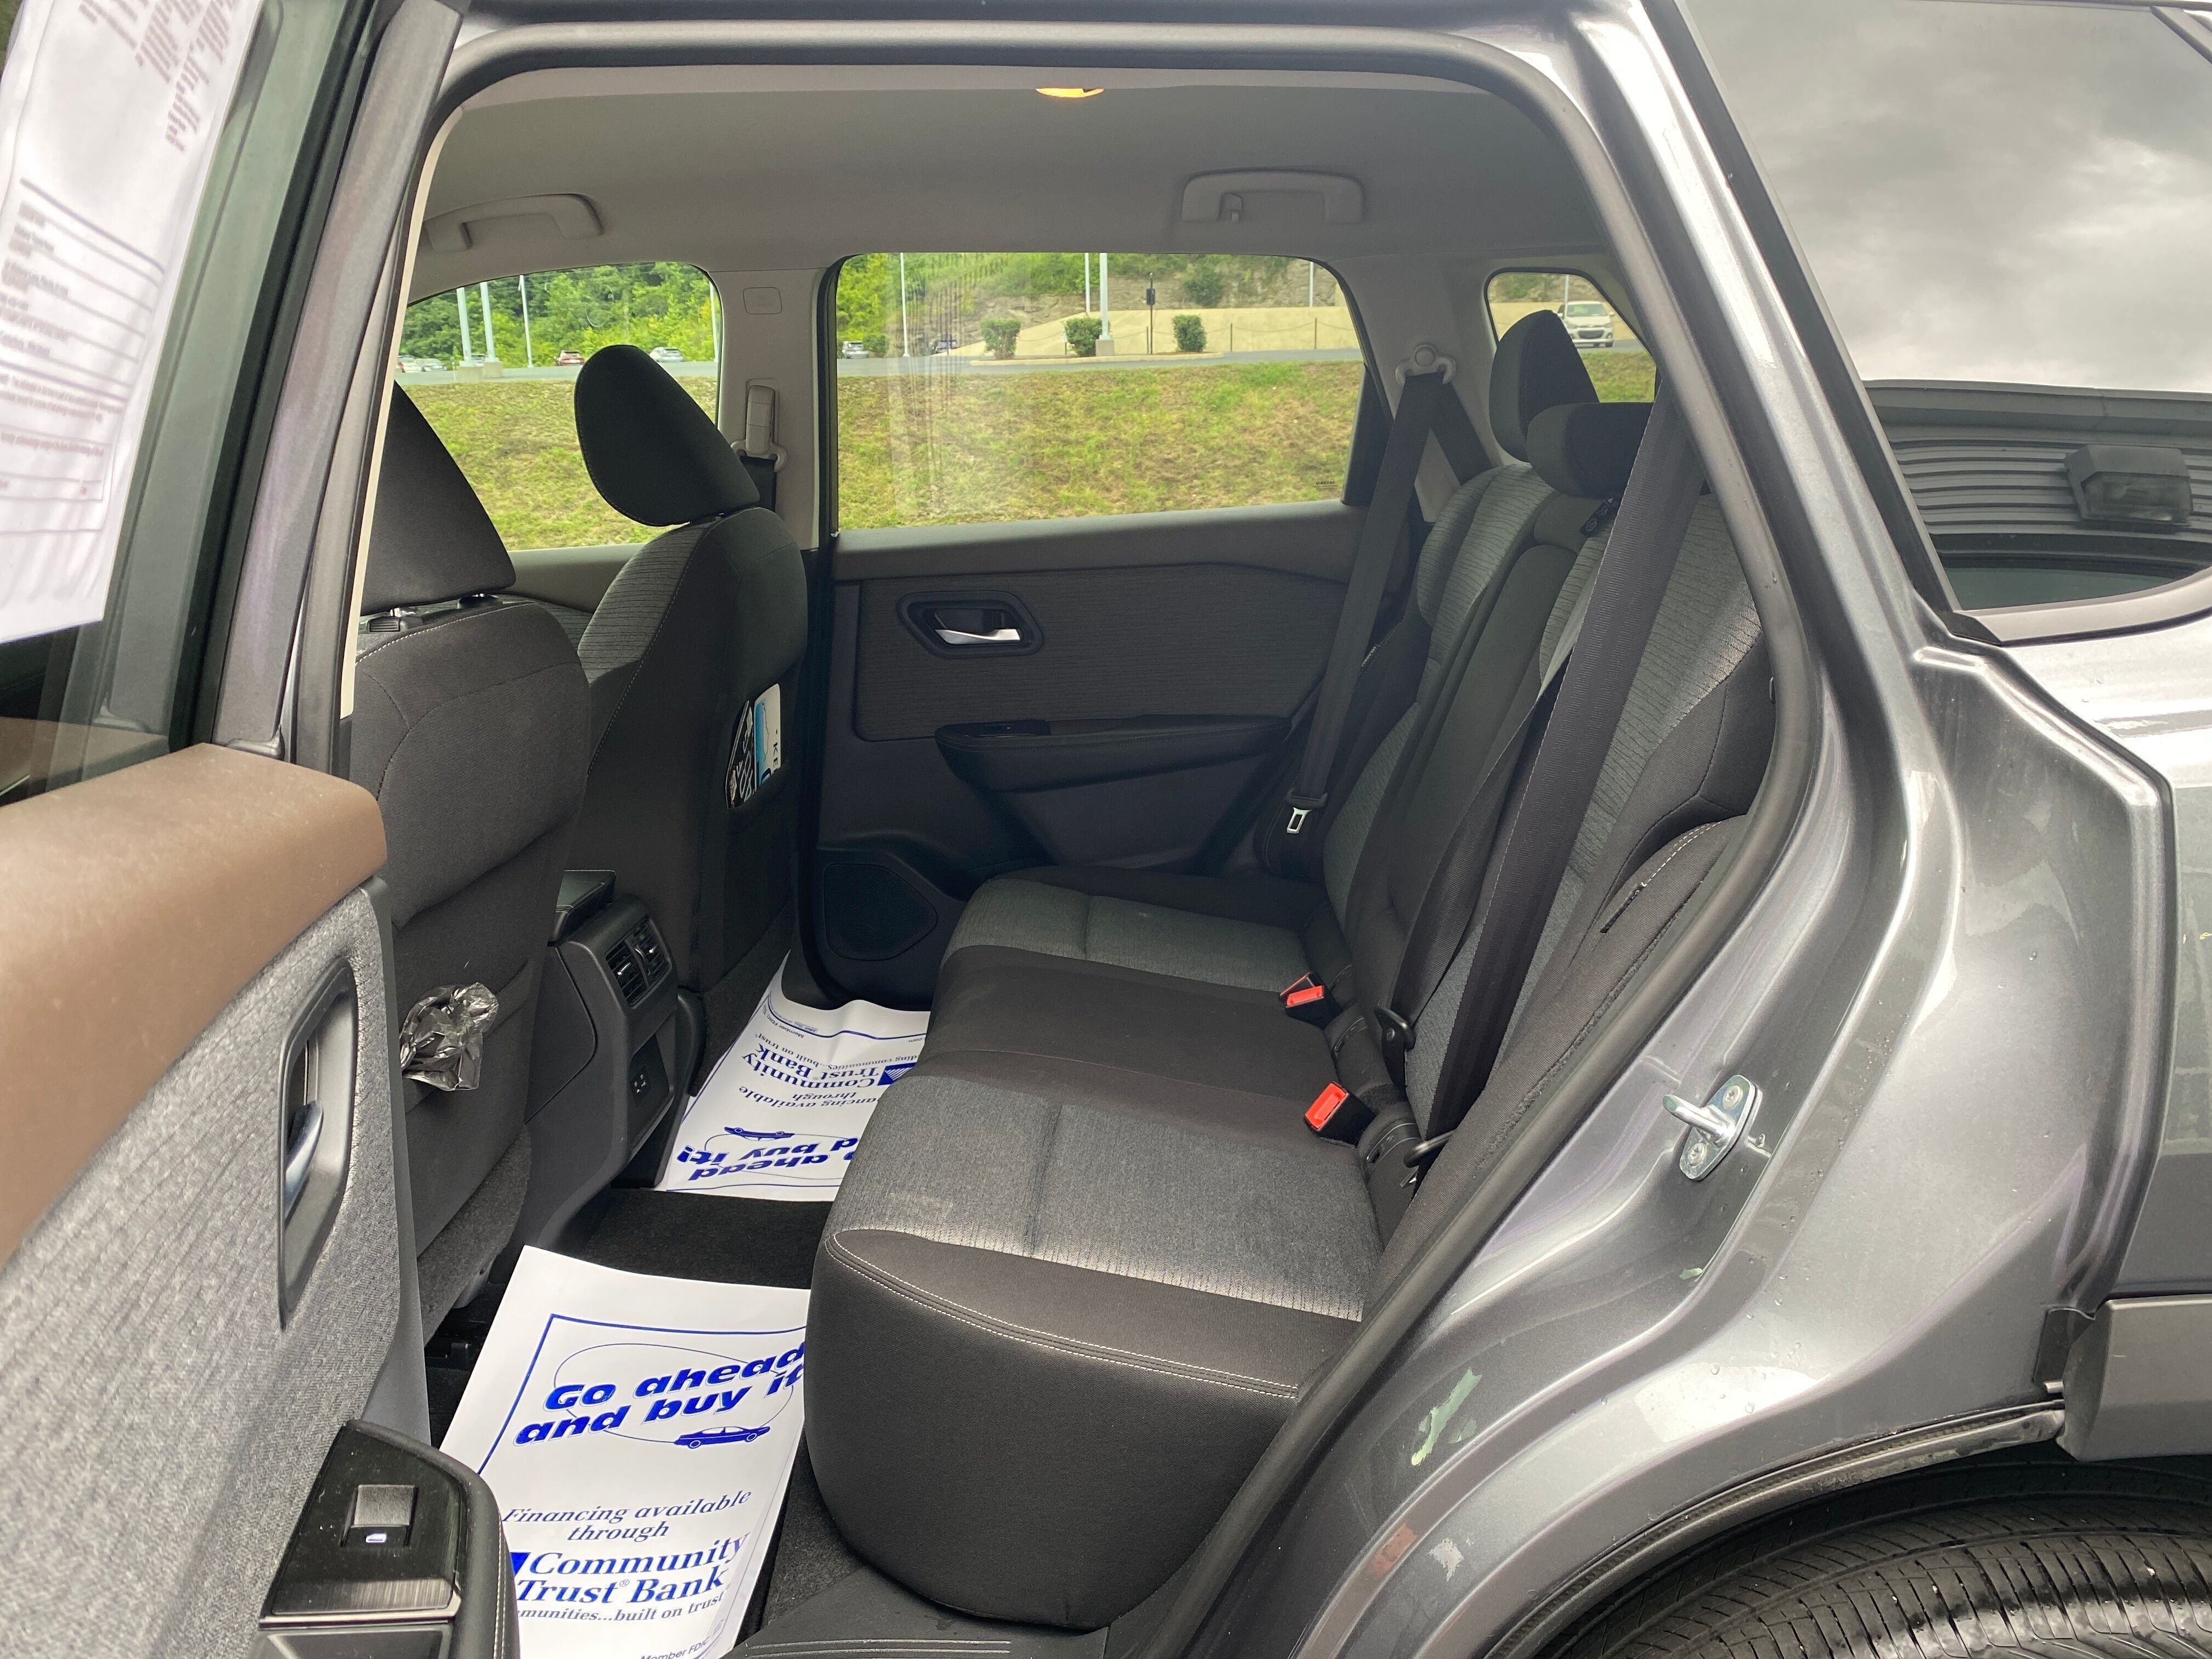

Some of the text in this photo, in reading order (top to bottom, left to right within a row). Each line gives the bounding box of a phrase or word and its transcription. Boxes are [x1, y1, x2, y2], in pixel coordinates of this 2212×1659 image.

[767, 1014, 778, 1026] FDIC
[779, 1025, 804, 1038] Member
[742, 1053, 875, 1088] Community
[755, 1043, 813, 1078] Bank
[739, 1086, 878, 1107] ancing available
[793, 1092, 857, 1101] through
[677, 1145, 729, 1164] it!
[738, 1143, 821, 1161] buy
[687, 1154, 831, 1181] ahead
[543, 1341, 805, 1412] Go ahead
[514, 1406, 630, 1446] and
[641, 1386, 753, 1424] buy
[501, 1489, 752, 1523] Financing available
[567, 1521, 670, 1542] through
[529, 1531, 751, 1575] Community
[627, 1564, 730, 1604] Bank
[518, 1608, 657, 1622] munities...built
[661, 1607, 682, 1619] on
